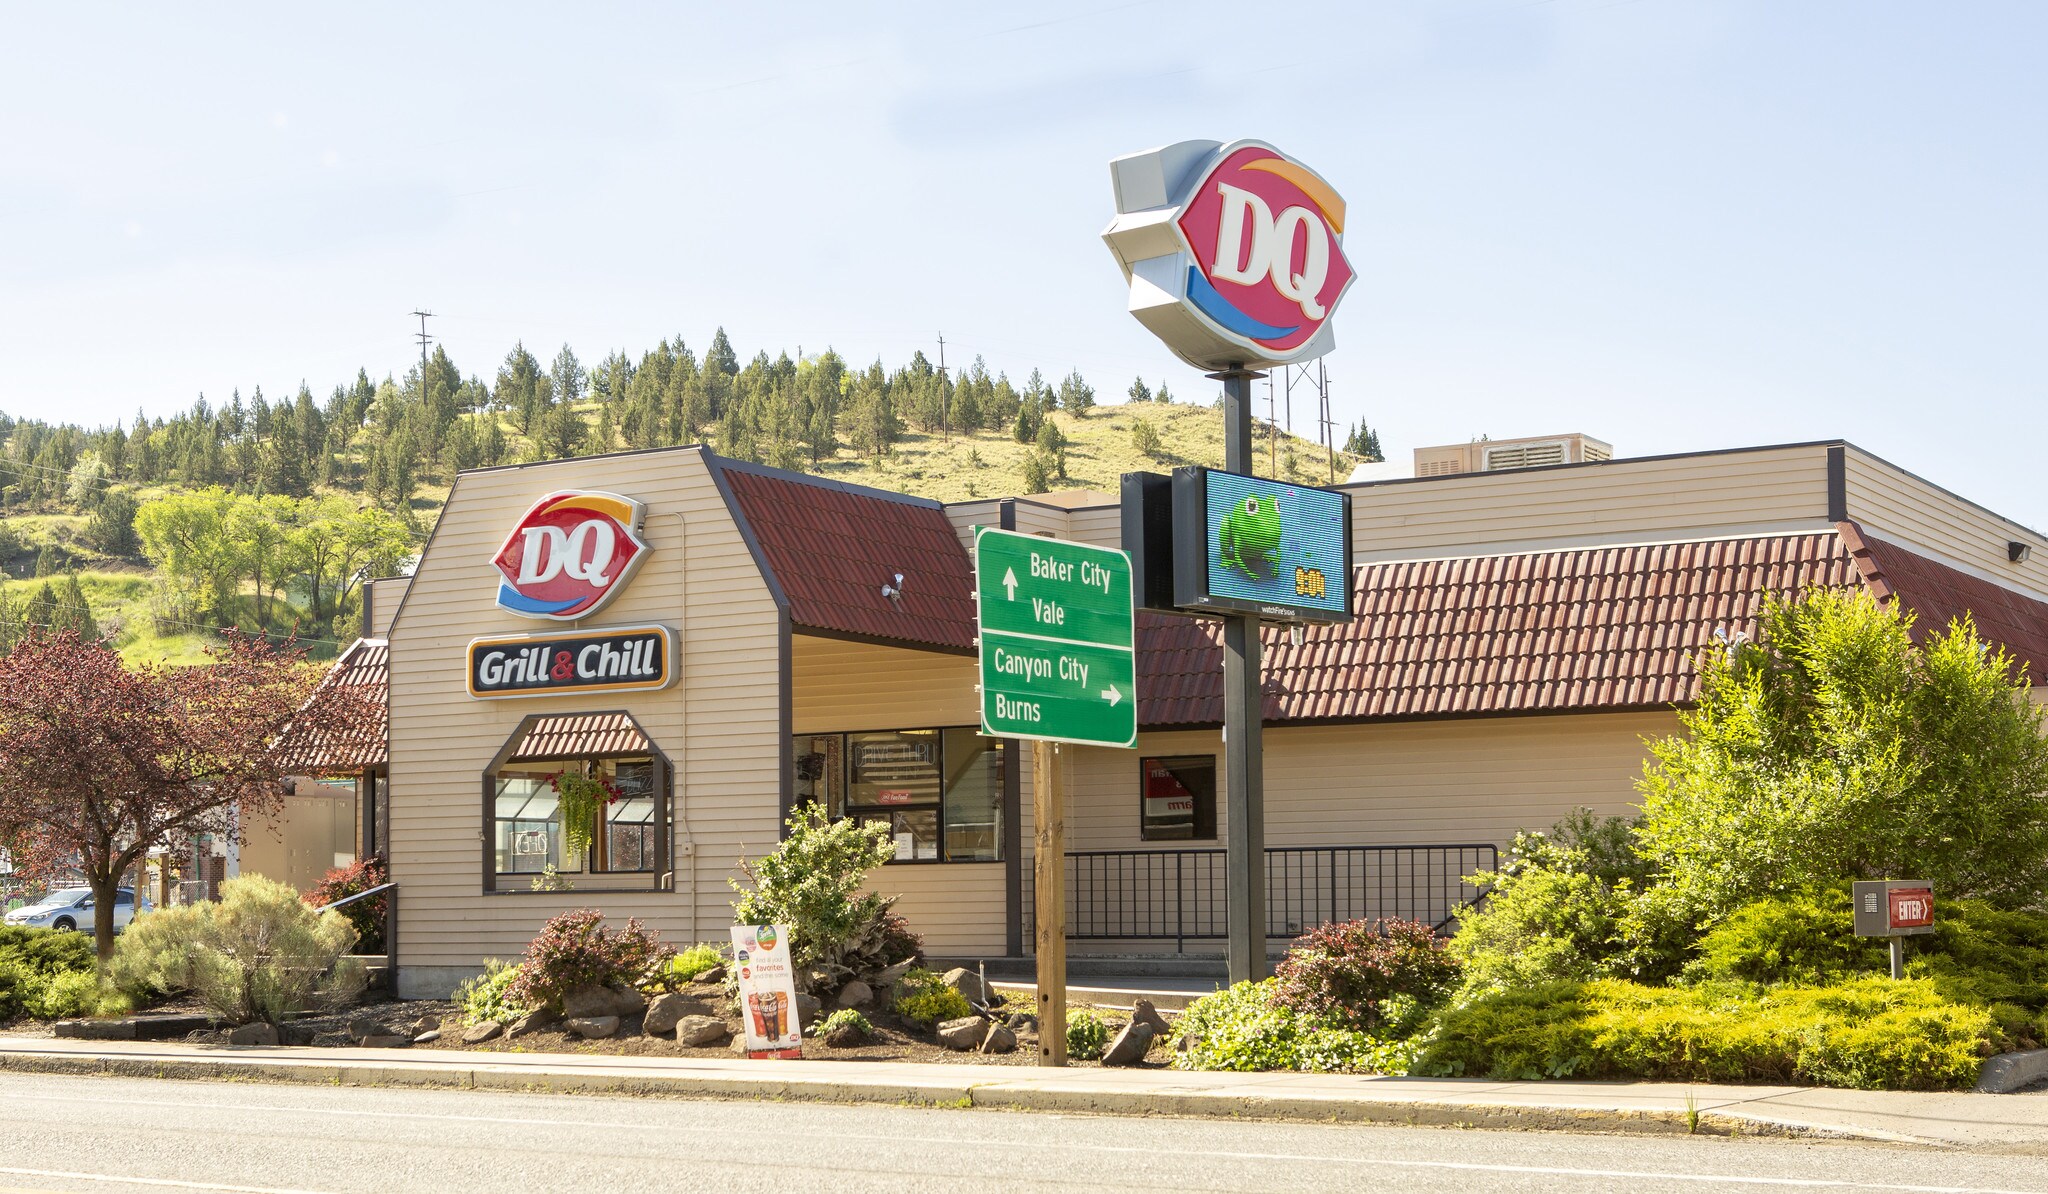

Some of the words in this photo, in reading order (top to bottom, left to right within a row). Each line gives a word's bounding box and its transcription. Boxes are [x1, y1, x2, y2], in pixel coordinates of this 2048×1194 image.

[1210, 181, 1330, 320] DQ
[517, 519, 616, 588] DQ
[1030, 552, 1074, 582] Baker
[1081, 560, 1110, 594] City
[1033, 598, 1064, 625] Vale
[995, 648, 1051, 683] Canyon
[1059, 656, 1088, 688] City
[996, 694, 1040, 722] Burns
[855, 744, 894, 767] DRIVE
[900, 743, 936, 765] THRU
[1898, 900, 1921, 921] ENTER
[756, 964, 784, 972] favorites
